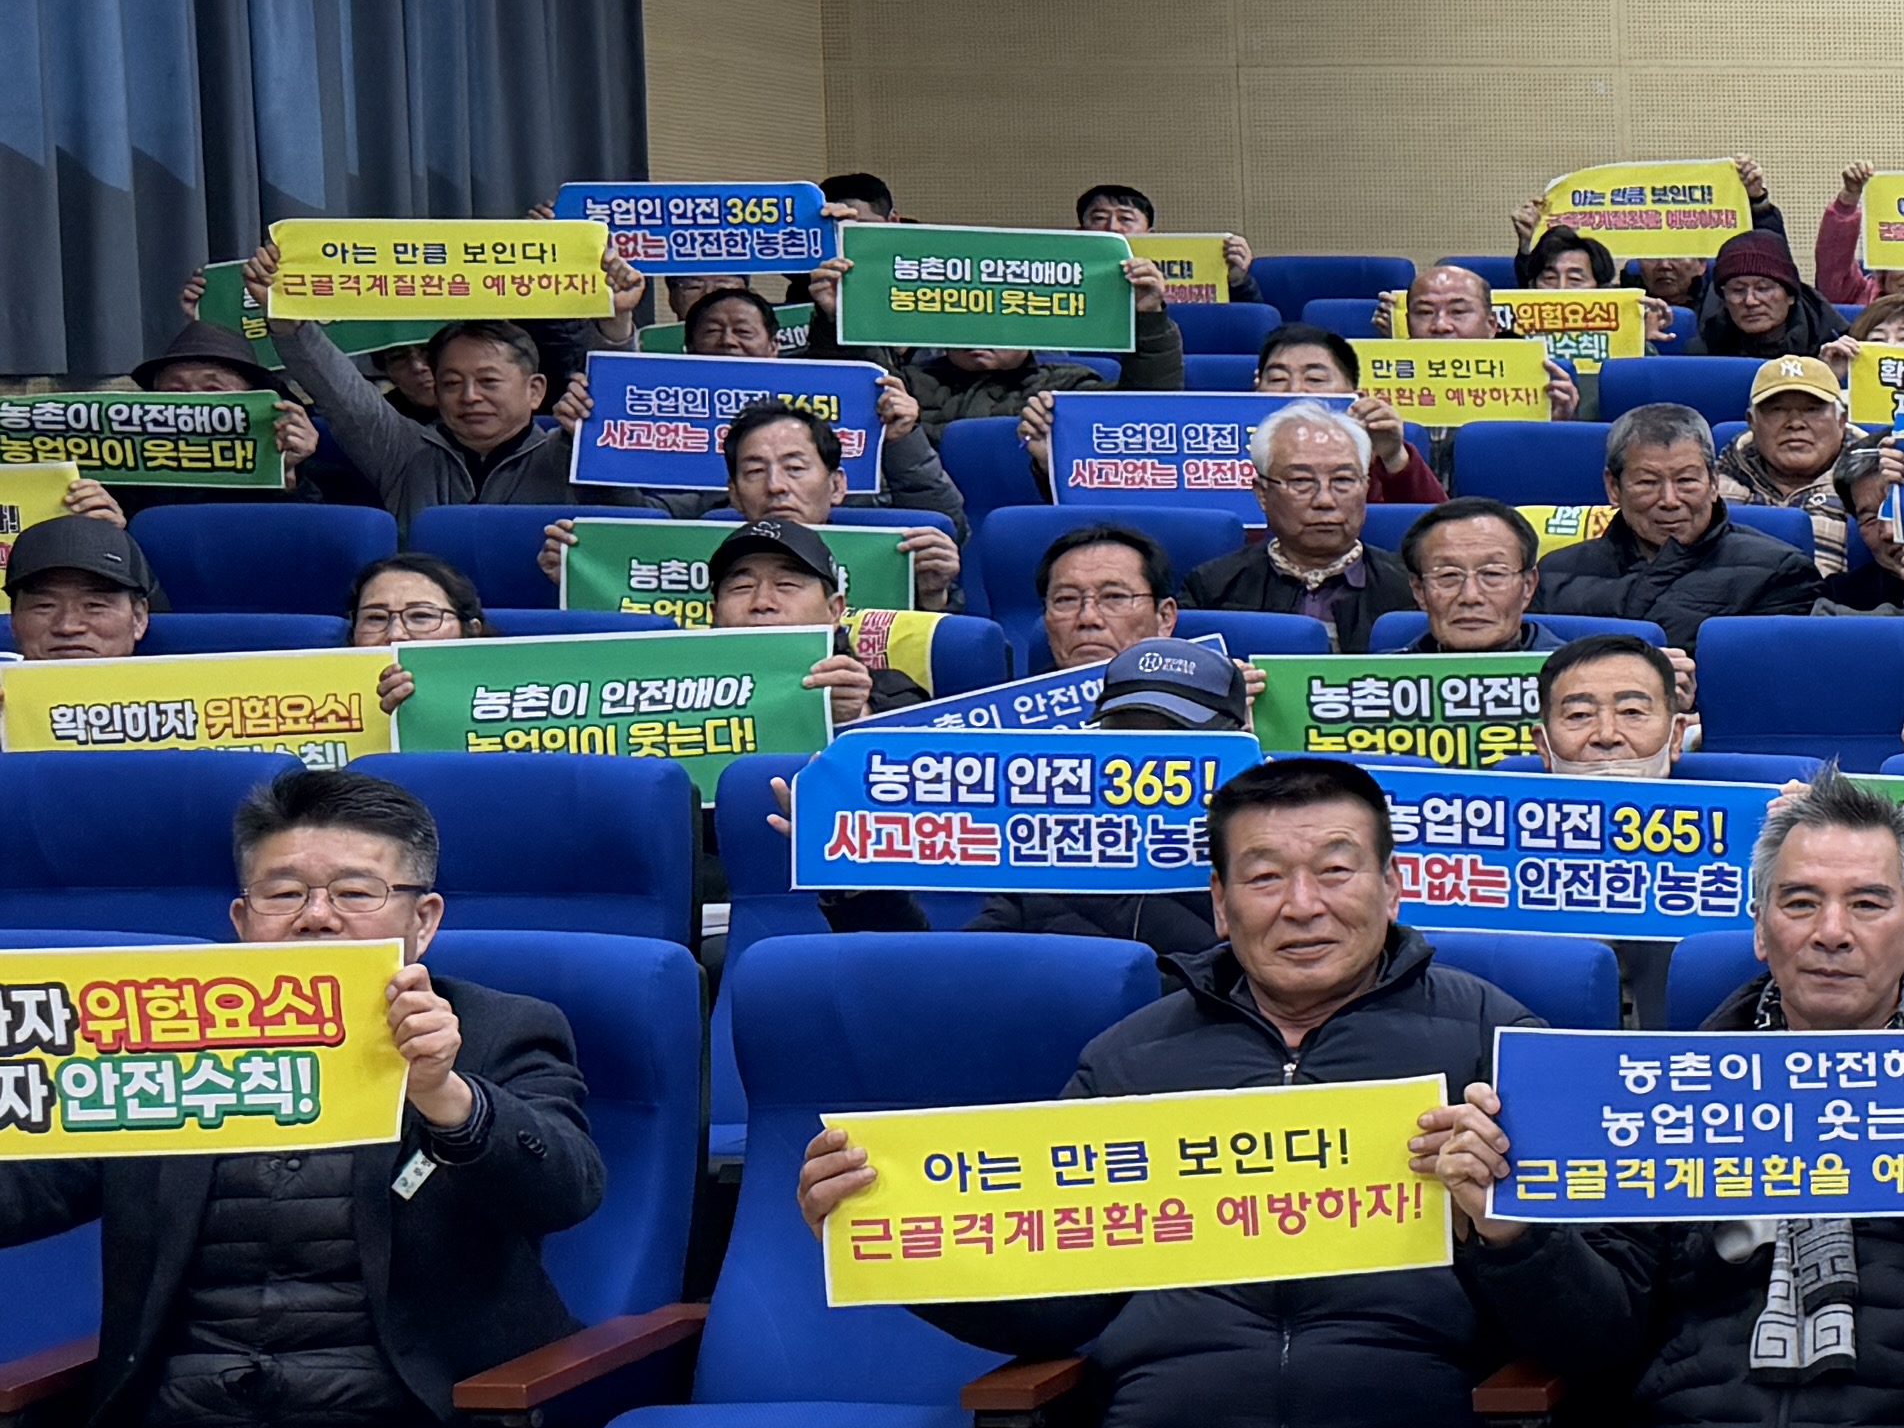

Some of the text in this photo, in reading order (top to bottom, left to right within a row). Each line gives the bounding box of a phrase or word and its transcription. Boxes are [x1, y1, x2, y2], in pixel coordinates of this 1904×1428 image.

[585, 197, 663, 226] 농업인
[668, 198, 720, 226] 안전
[322, 241, 377, 265] 아는
[393, 241, 448, 265] 만큼
[463, 241, 558, 266] 보인다!
[671, 230, 748, 259] 안전한
[282, 272, 597, 298] 근골격계질환을 예방하자!
[893, 255, 1083, 286] 농촌이 안전해야
[1515, 302, 1619, 330] 위험요소!
[1371, 359, 1505, 380] 만큼 보인다!
[1446, 385, 1539, 407] 예방하자!
[107, 404, 246, 435] 안전해야
[597, 421, 708, 453] 사고없는
[144, 441, 255, 471] 웃는다!
[50, 693, 365, 745] 확인하자 위험요소!
[472, 675, 754, 721] 농촌이 안전해야
[1309, 675, 1430, 719] 농촌이
[867, 754, 1092, 805] 농업인 안전
[826, 811, 1001, 865] 사고없는
[1009, 815, 1138, 866] 안전한
[1517, 803, 1601, 850] 안전
[1517, 858, 1648, 914] 안전한
[82, 979, 342, 1048] 위험요소!
[58, 1052, 317, 1124] 안전수칙!
[1616, 1051, 1762, 1095] 농촌이
[1600, 1101, 1795, 1148] 농업인이
[923, 1127, 1351, 1193] 아는 만큼 보인다!
[1515, 1151, 1852, 1201] 근골격계질환을
[849, 1181, 1424, 1260] 근골격계질환을 예방하자!
